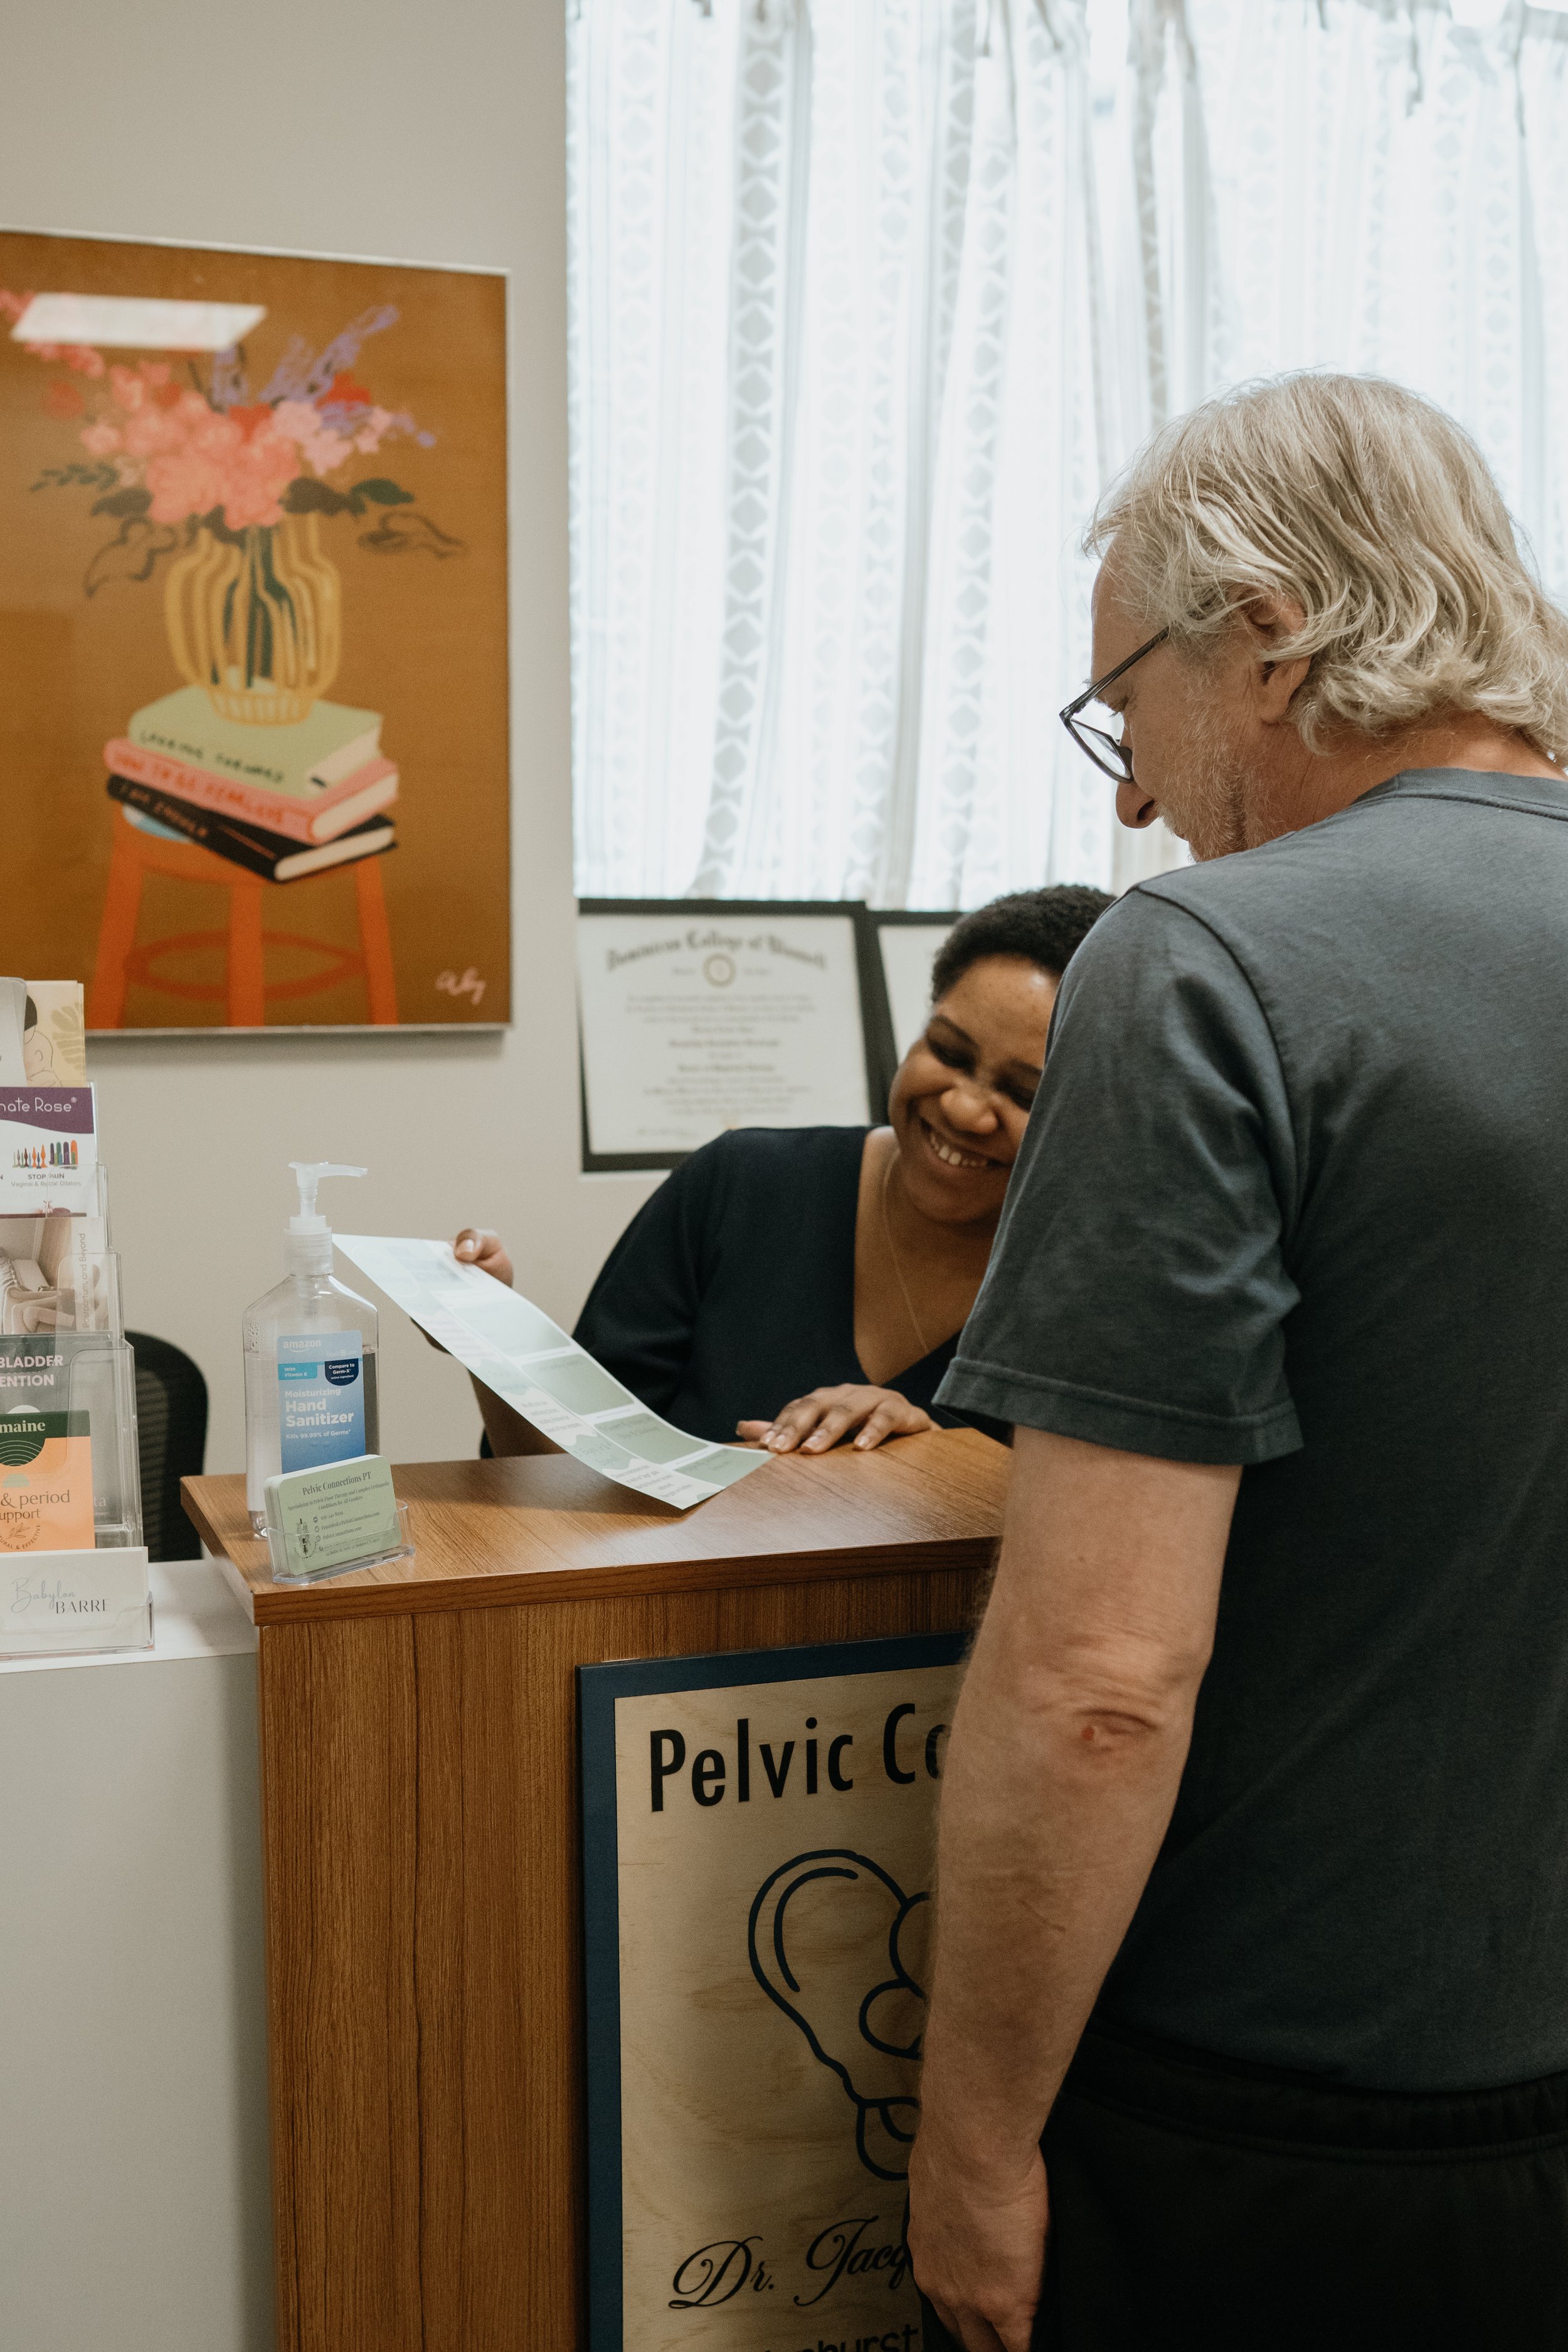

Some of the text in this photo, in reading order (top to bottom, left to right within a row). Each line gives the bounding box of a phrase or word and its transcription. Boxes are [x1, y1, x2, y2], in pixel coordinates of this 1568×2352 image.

[78, 1233, 88, 1262] Beyond
[283, 1340, 322, 1349] amazon
[285, 1389, 341, 1397] Moisturizing
[285, 1398, 327, 1412] Hand
[0, 1420, 46, 1434] maine
[285, 1412, 354, 1428] Sanitizer
[302, 1471, 372, 1496] Pelvic Connections PT
[1, 1489, 70, 1509] & period
[0, 1535, 13, 1549] URAL
[56, 1599, 111, 1614] BARRE
[650, 1717, 854, 1813] Pelvic
[668, 2235, 775, 2309] Dr.
